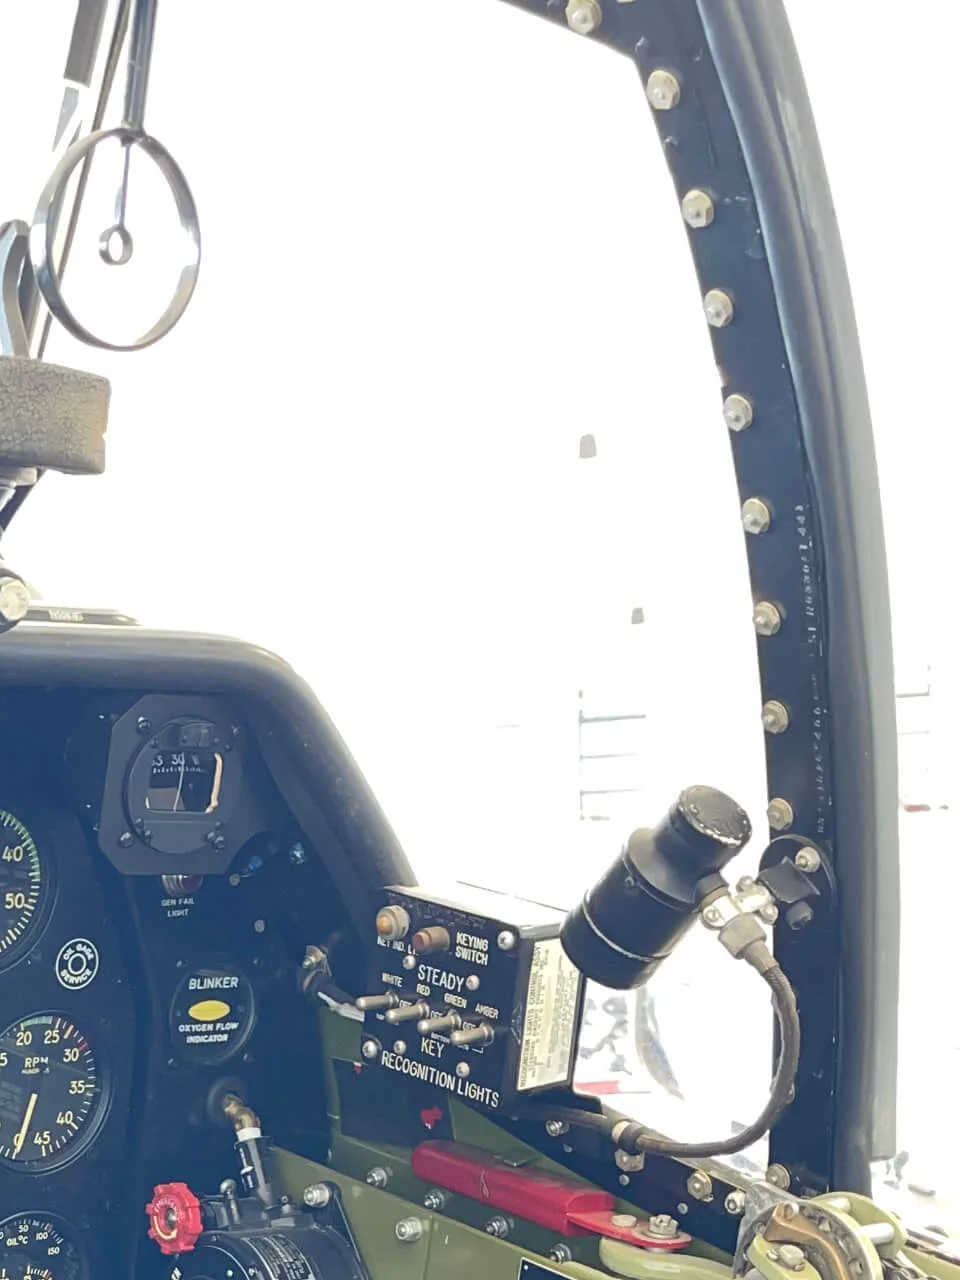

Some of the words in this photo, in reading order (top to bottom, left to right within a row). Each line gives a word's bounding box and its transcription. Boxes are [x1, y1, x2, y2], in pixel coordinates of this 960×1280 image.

[456, 931, 488, 951] KEYING
[456, 946, 488, 965] SWITCH
[189, 976, 239, 990] BLINKER
[418, 965, 464, 992] STEADY
[475, 1003, 498, 1019] AMBER
[179, 1023, 212, 1032] OXYGEN
[215, 1022, 239, 1031] FLOW
[186, 1033, 228, 1043] INDICATOR
[421, 1037, 444, 1058] KEY
[24, 1056, 48, 1068] RPM
[382, 1050, 455, 1090] RECOGNITION
[458, 1081, 499, 1108] LIGHTS
